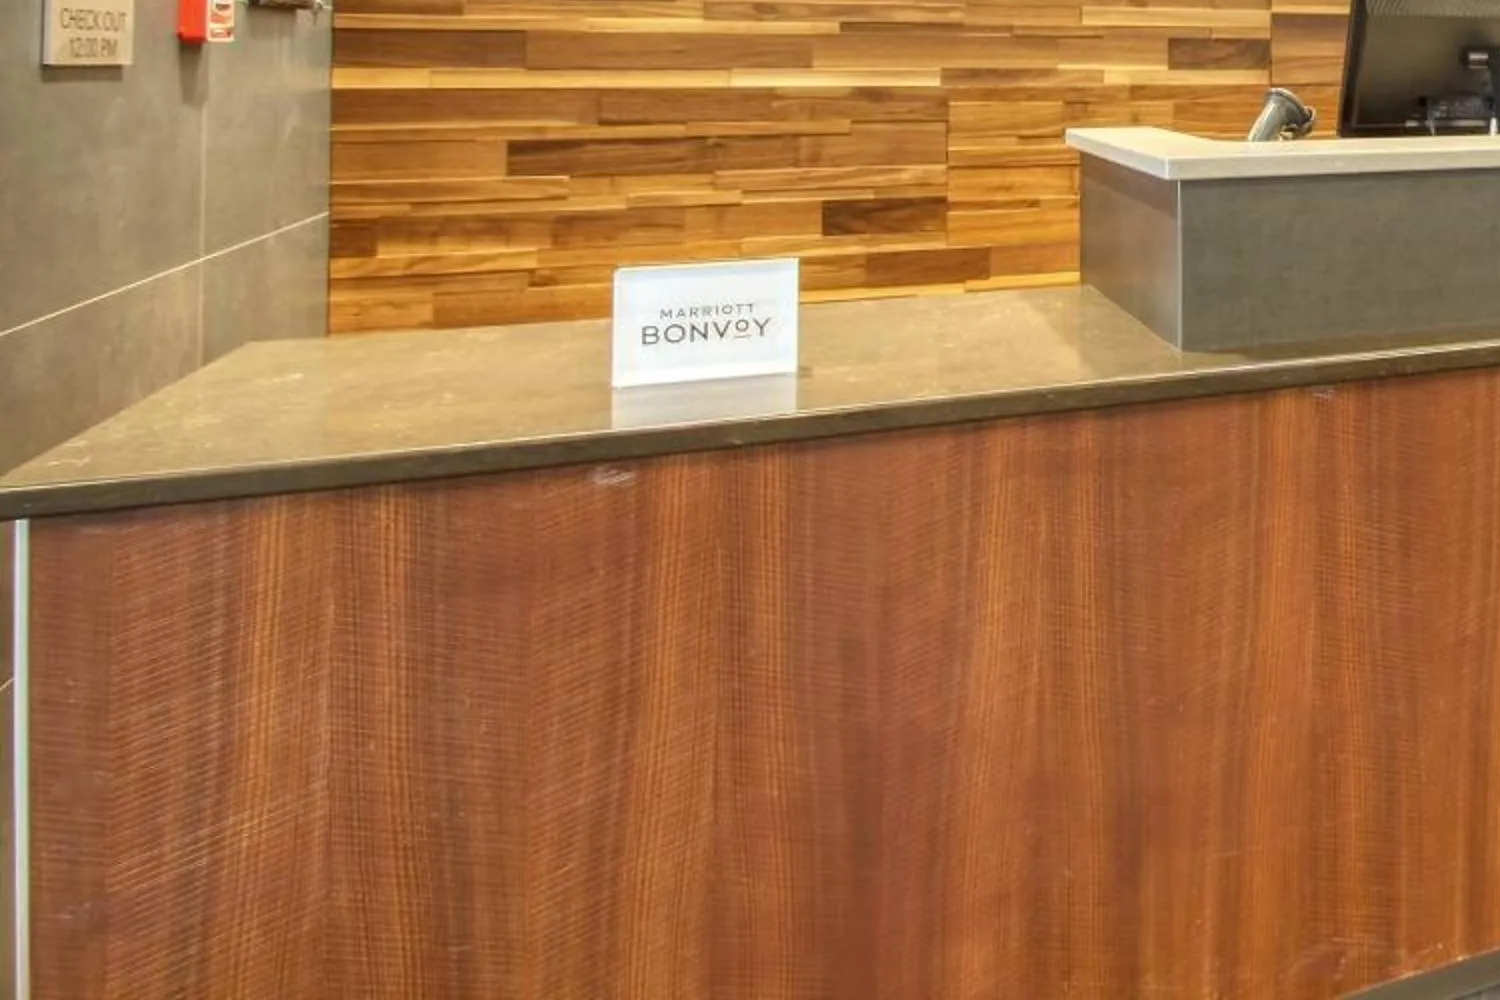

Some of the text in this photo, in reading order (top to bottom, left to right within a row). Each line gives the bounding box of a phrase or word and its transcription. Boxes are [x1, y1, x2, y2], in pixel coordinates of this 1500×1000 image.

[60, 7, 127, 33] CHECK OUT
[100, 37, 118, 58] PM
[659, 303, 754, 320] MARRIOTT
[641, 317, 772, 346] BONVOY
